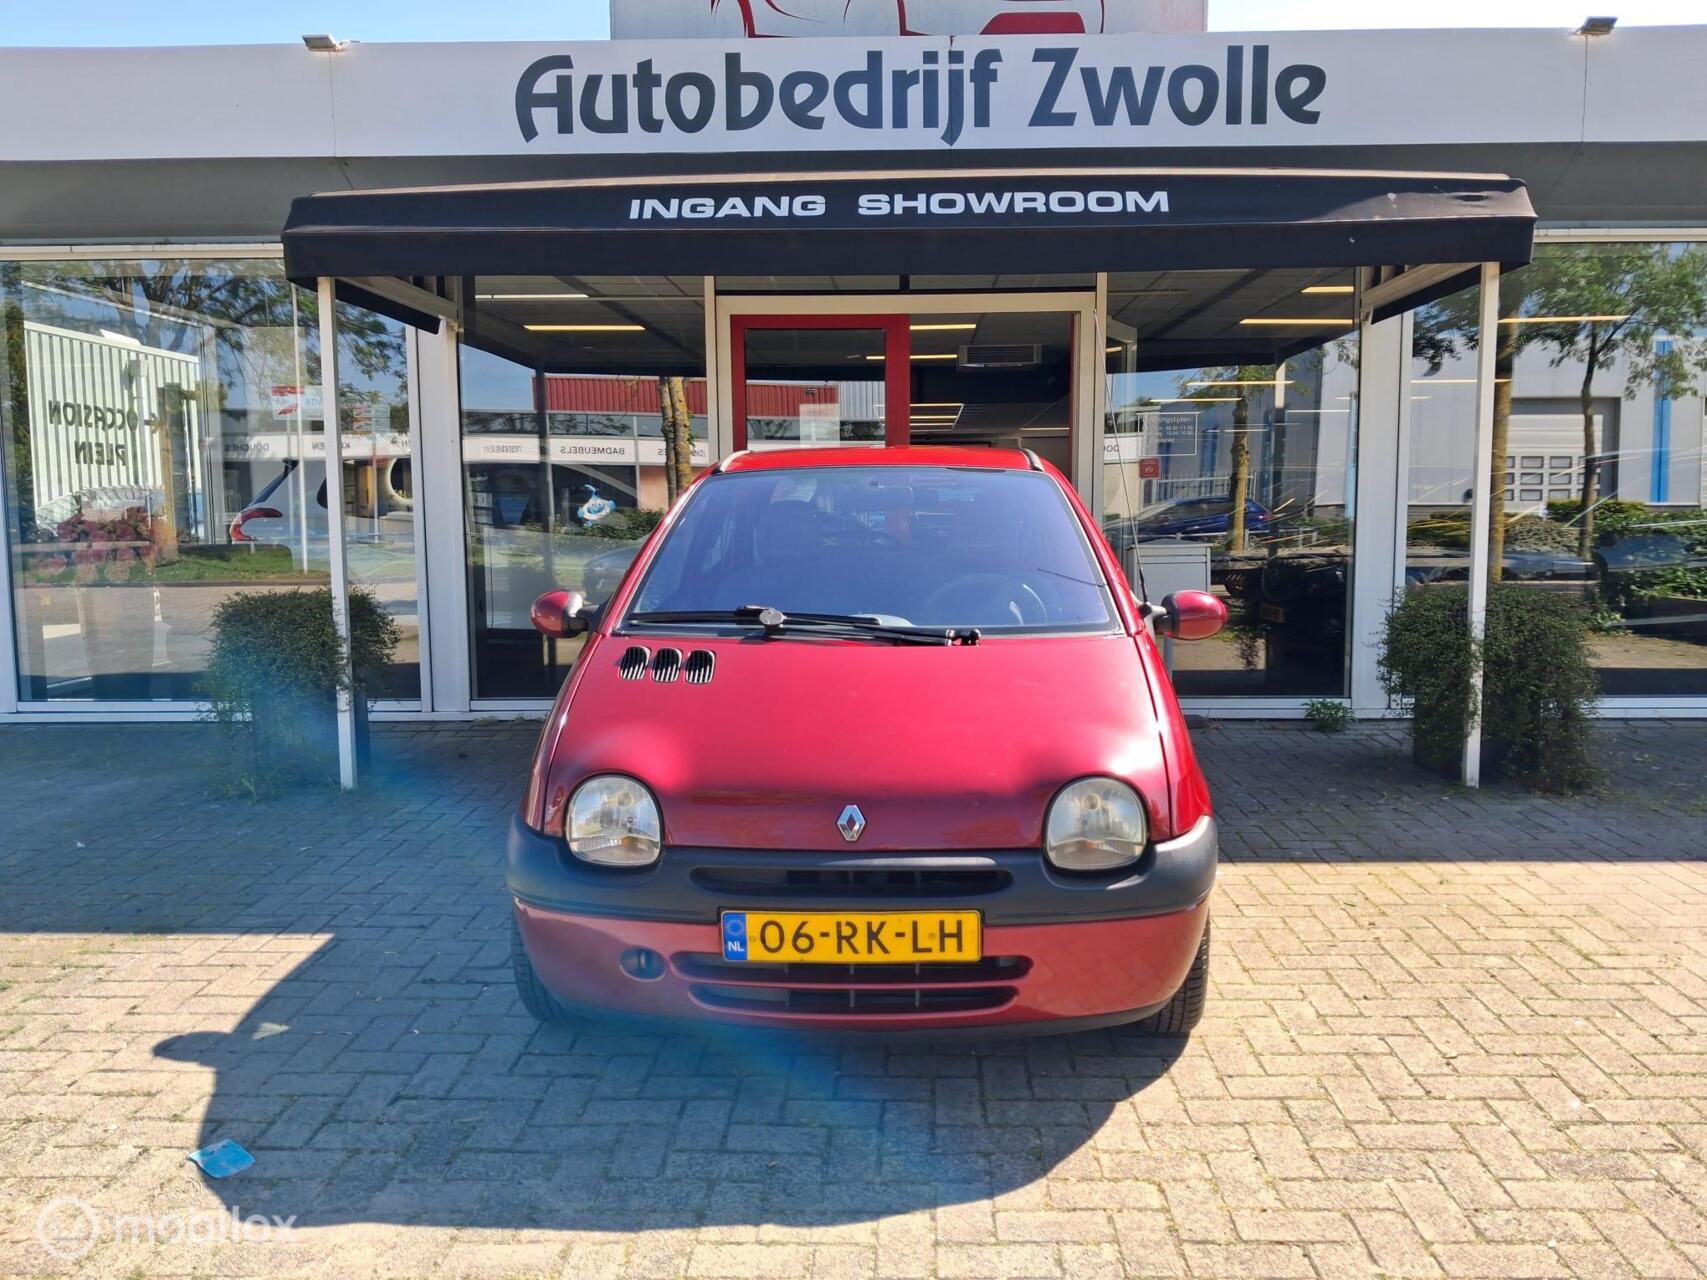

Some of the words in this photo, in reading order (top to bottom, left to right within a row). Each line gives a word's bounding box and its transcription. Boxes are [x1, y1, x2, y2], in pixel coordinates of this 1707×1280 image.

[515, 49, 1003, 146] Autobedrijf
[1028, 45, 1327, 127] Zwolle
[629, 195, 826, 220] INGANG
[858, 190, 1170, 217] SHOWROOM
[727, 941, 745, 953] NL
[759, 919, 964, 955] 06-RK-LH
